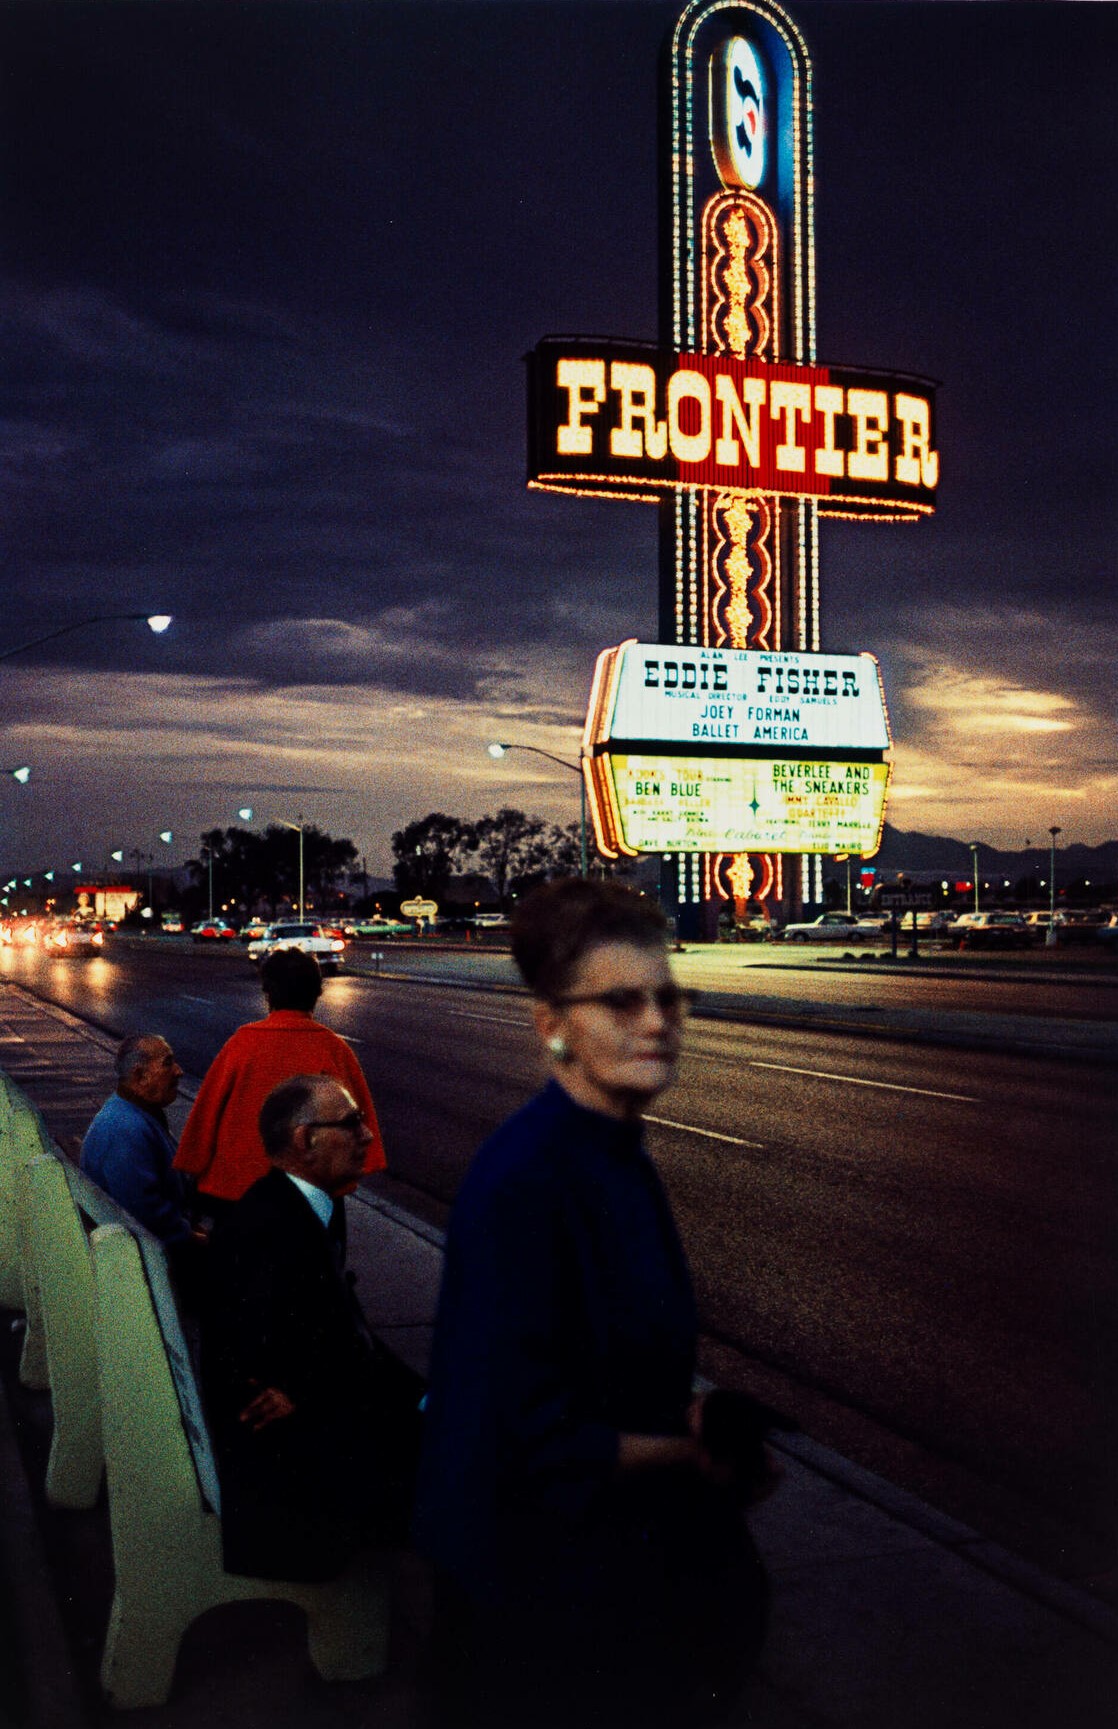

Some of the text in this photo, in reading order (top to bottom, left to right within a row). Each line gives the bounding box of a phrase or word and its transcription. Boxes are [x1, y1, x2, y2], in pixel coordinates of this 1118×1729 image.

[556, 357, 939, 490] FRONTIER
[700, 651, 800, 664] ALAN LEE PRESENTS
[645, 660, 859, 697] EDDIE FISHER
[664, 691, 700, 699] MUSICAL
[708, 692, 748, 701] DIRECTOR
[800, 697, 838, 705] SAMUELS
[700, 705, 800, 722] JOEY FORMAN
[692, 723, 809, 741] BALLET AMERICA
[773, 764, 870, 780] BEVERLEE AND
[635, 781, 702, 797] BEN BLUE
[773, 779, 870, 795] THE SNEAKERS
